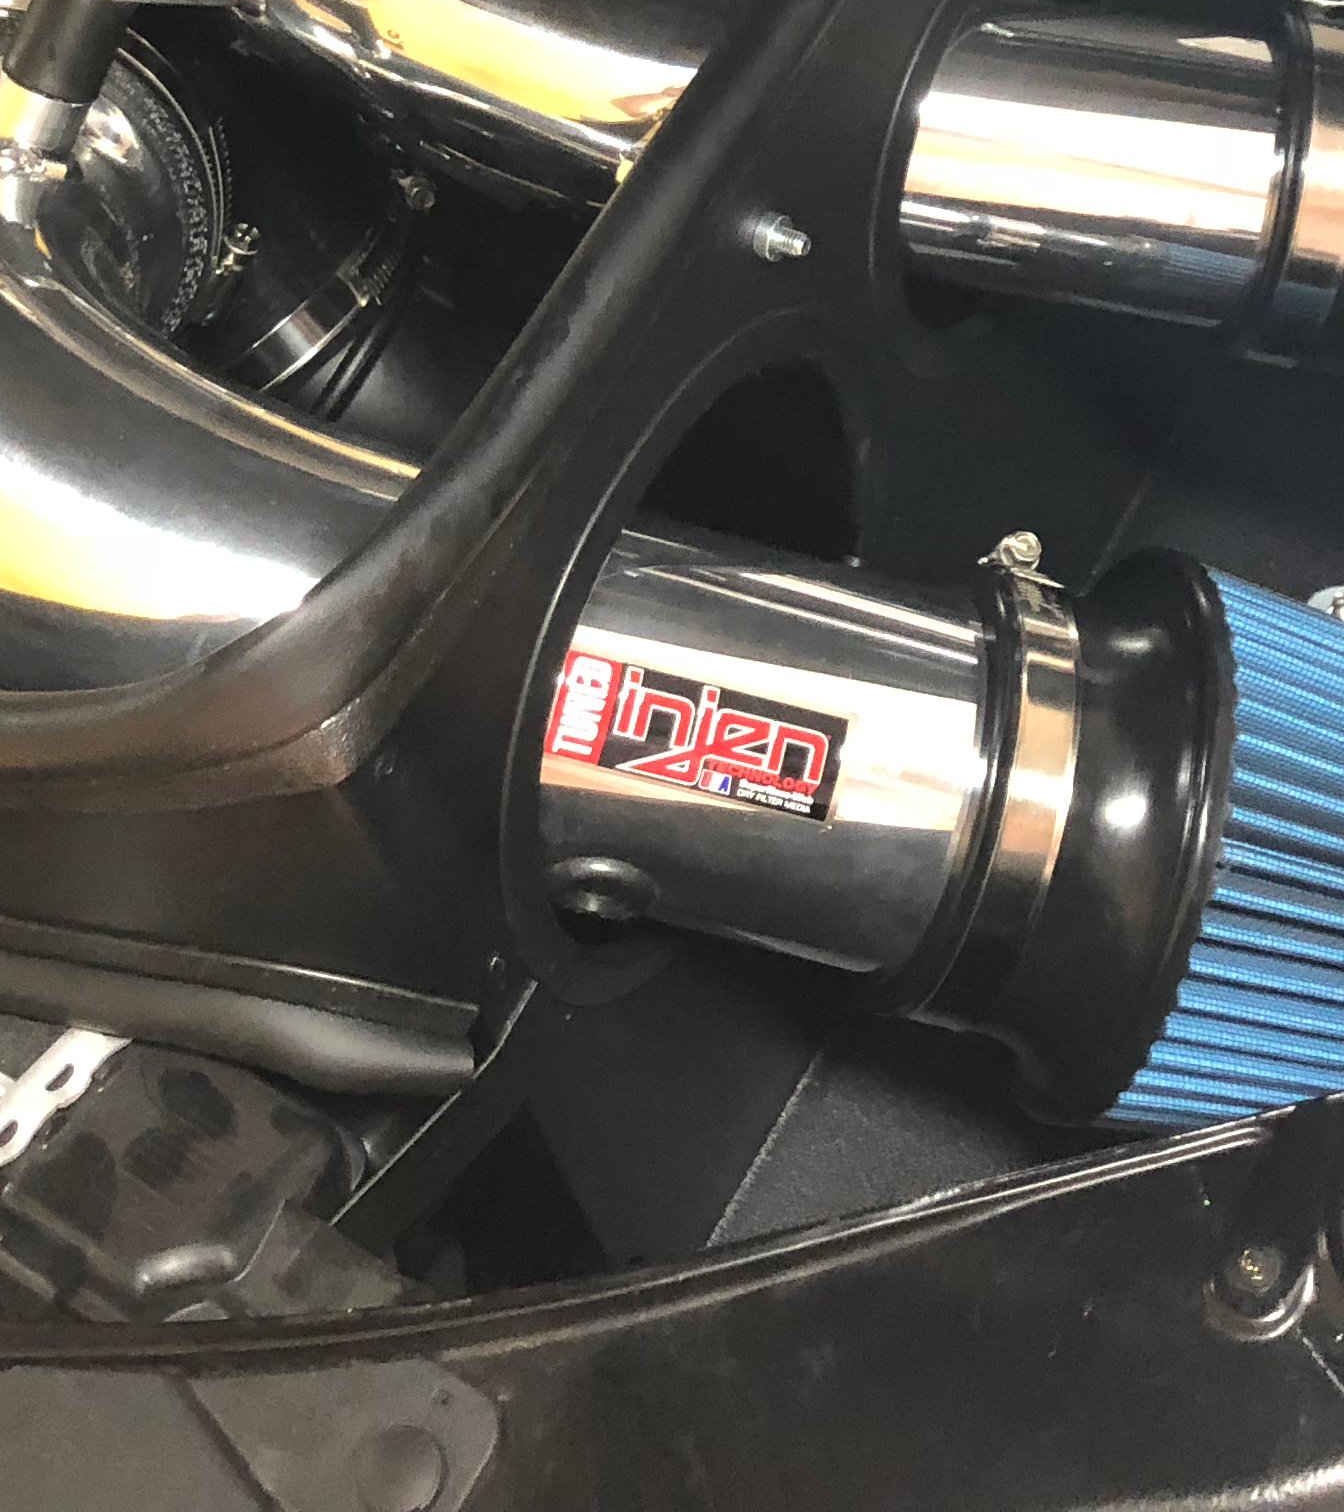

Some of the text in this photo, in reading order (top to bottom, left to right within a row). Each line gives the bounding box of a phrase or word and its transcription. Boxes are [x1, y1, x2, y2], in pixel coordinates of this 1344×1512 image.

[552, 655, 614, 756] TUNED
[613, 665, 830, 786] injen
[707, 758, 818, 796] TECHNOLOGY
[756, 793, 783, 807] FILTER
[783, 800, 811, 814] MEDIA
